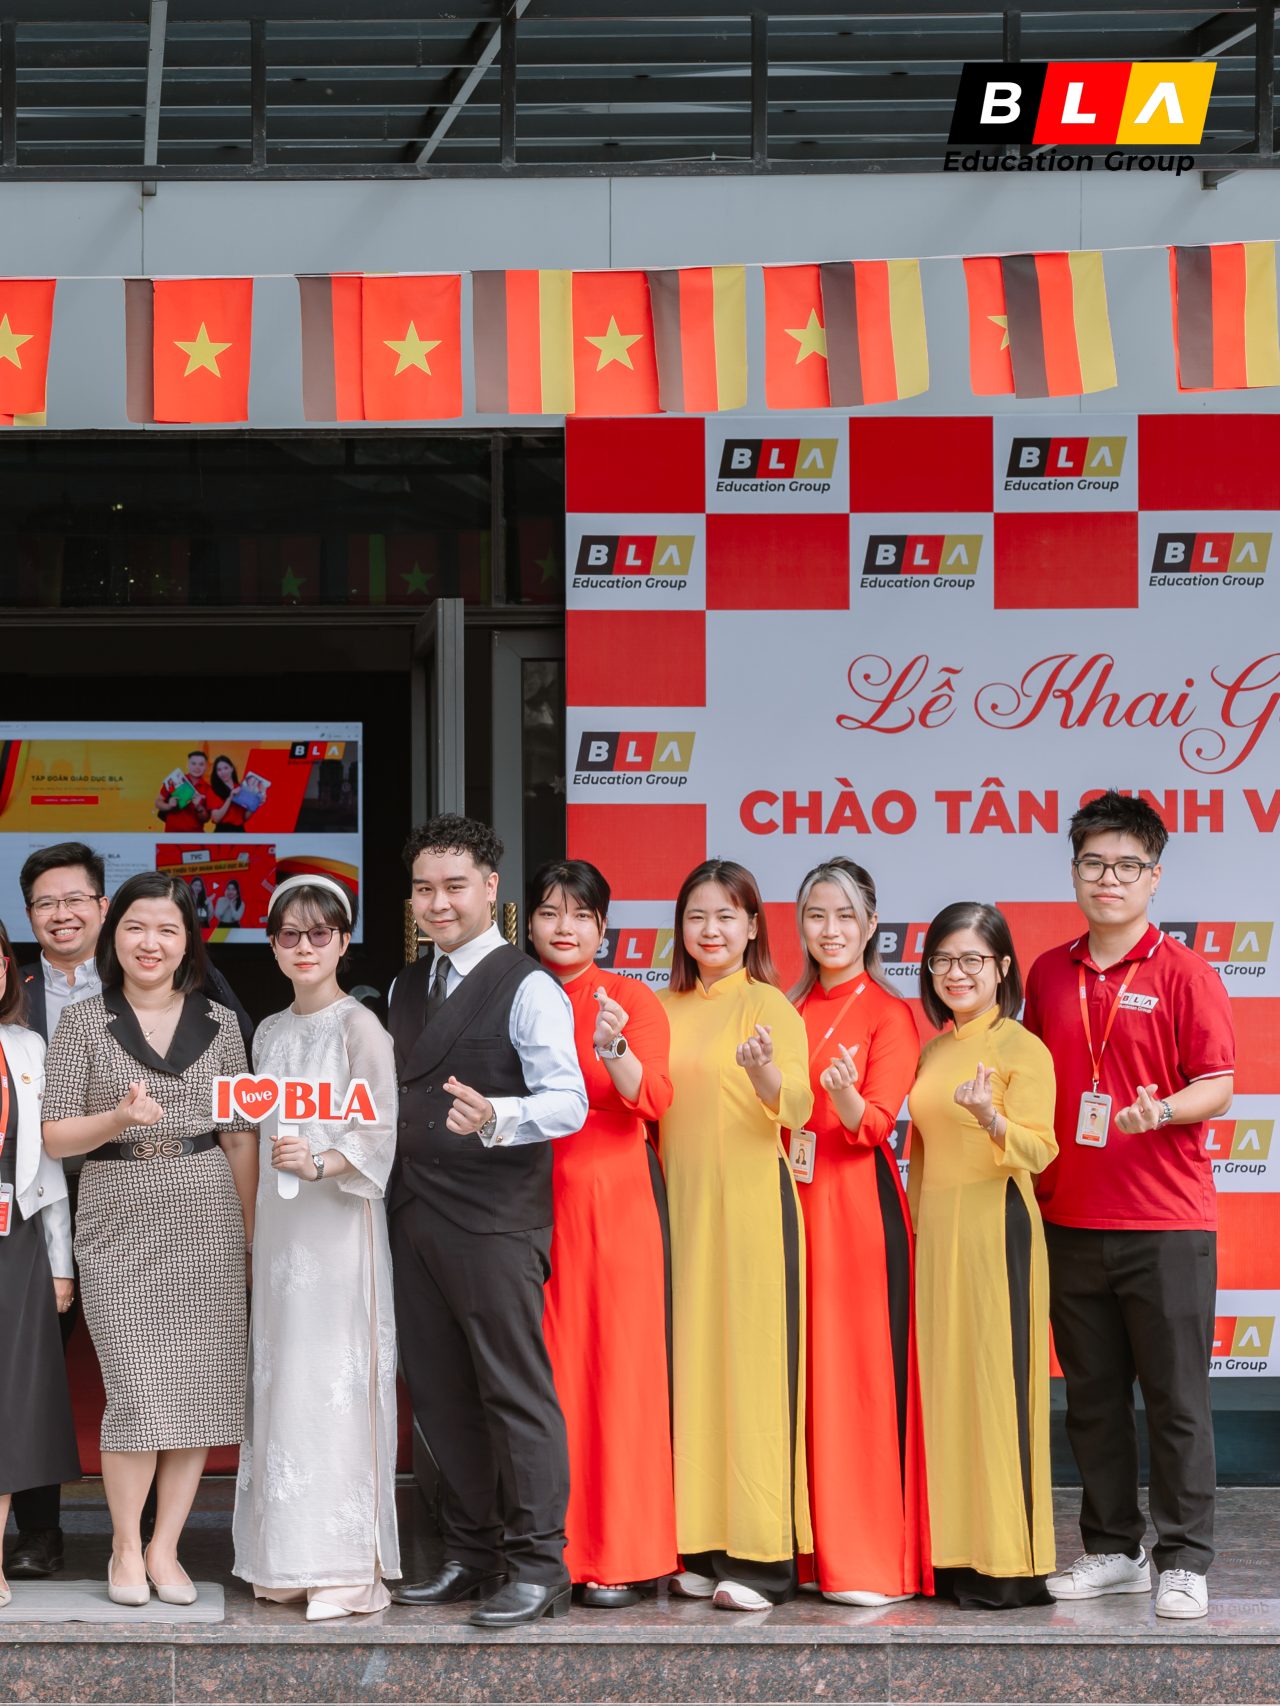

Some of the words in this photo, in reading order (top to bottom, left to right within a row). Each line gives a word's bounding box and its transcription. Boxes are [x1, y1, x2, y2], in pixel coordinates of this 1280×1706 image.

[730, 448, 824, 469] BLA
[1019, 446, 1114, 468] BLA
[716, 480, 786, 492] Education
[788, 480, 831, 494] Group
[1004, 479, 1074, 491] Education
[1077, 480, 1119, 493] Group
[587, 544, 681, 566] BLA
[875, 544, 969, 566] BLA
[1164, 541, 1258, 563] BLA
[572, 577, 642, 589] Education
[645, 577, 687, 591] Group
[860, 576, 930, 589] Education
[933, 577, 975, 591] Group
[1149, 575, 1218, 587] Education
[1223, 575, 1265, 589] Group
[836, 654, 964, 734] Lễ
[974, 653, 1197, 729] Khai
[1179, 653, 1280, 775] G
[295, 745, 339, 756] BLA
[587, 741, 682, 762] BLA
[573, 774, 643, 785] Education
[645, 774, 688, 787] Group
[740, 777, 917, 835] CHÀO
[935, 777, 1059, 834] TÂN
[1079, 789, 1224, 833] NH
[1242, 789, 1280, 833] V
[646, 971, 670, 981] Gro
[1224, 964, 1266, 978] Group
[217, 1081, 231, 1119] I
[241, 1089, 272, 1104] love
[284, 1081, 377, 1121] BLA
[1204, 1128, 1261, 1151] LA
[1225, 1162, 1267, 1176] Group
[1225, 1359, 1268, 1373] Group
